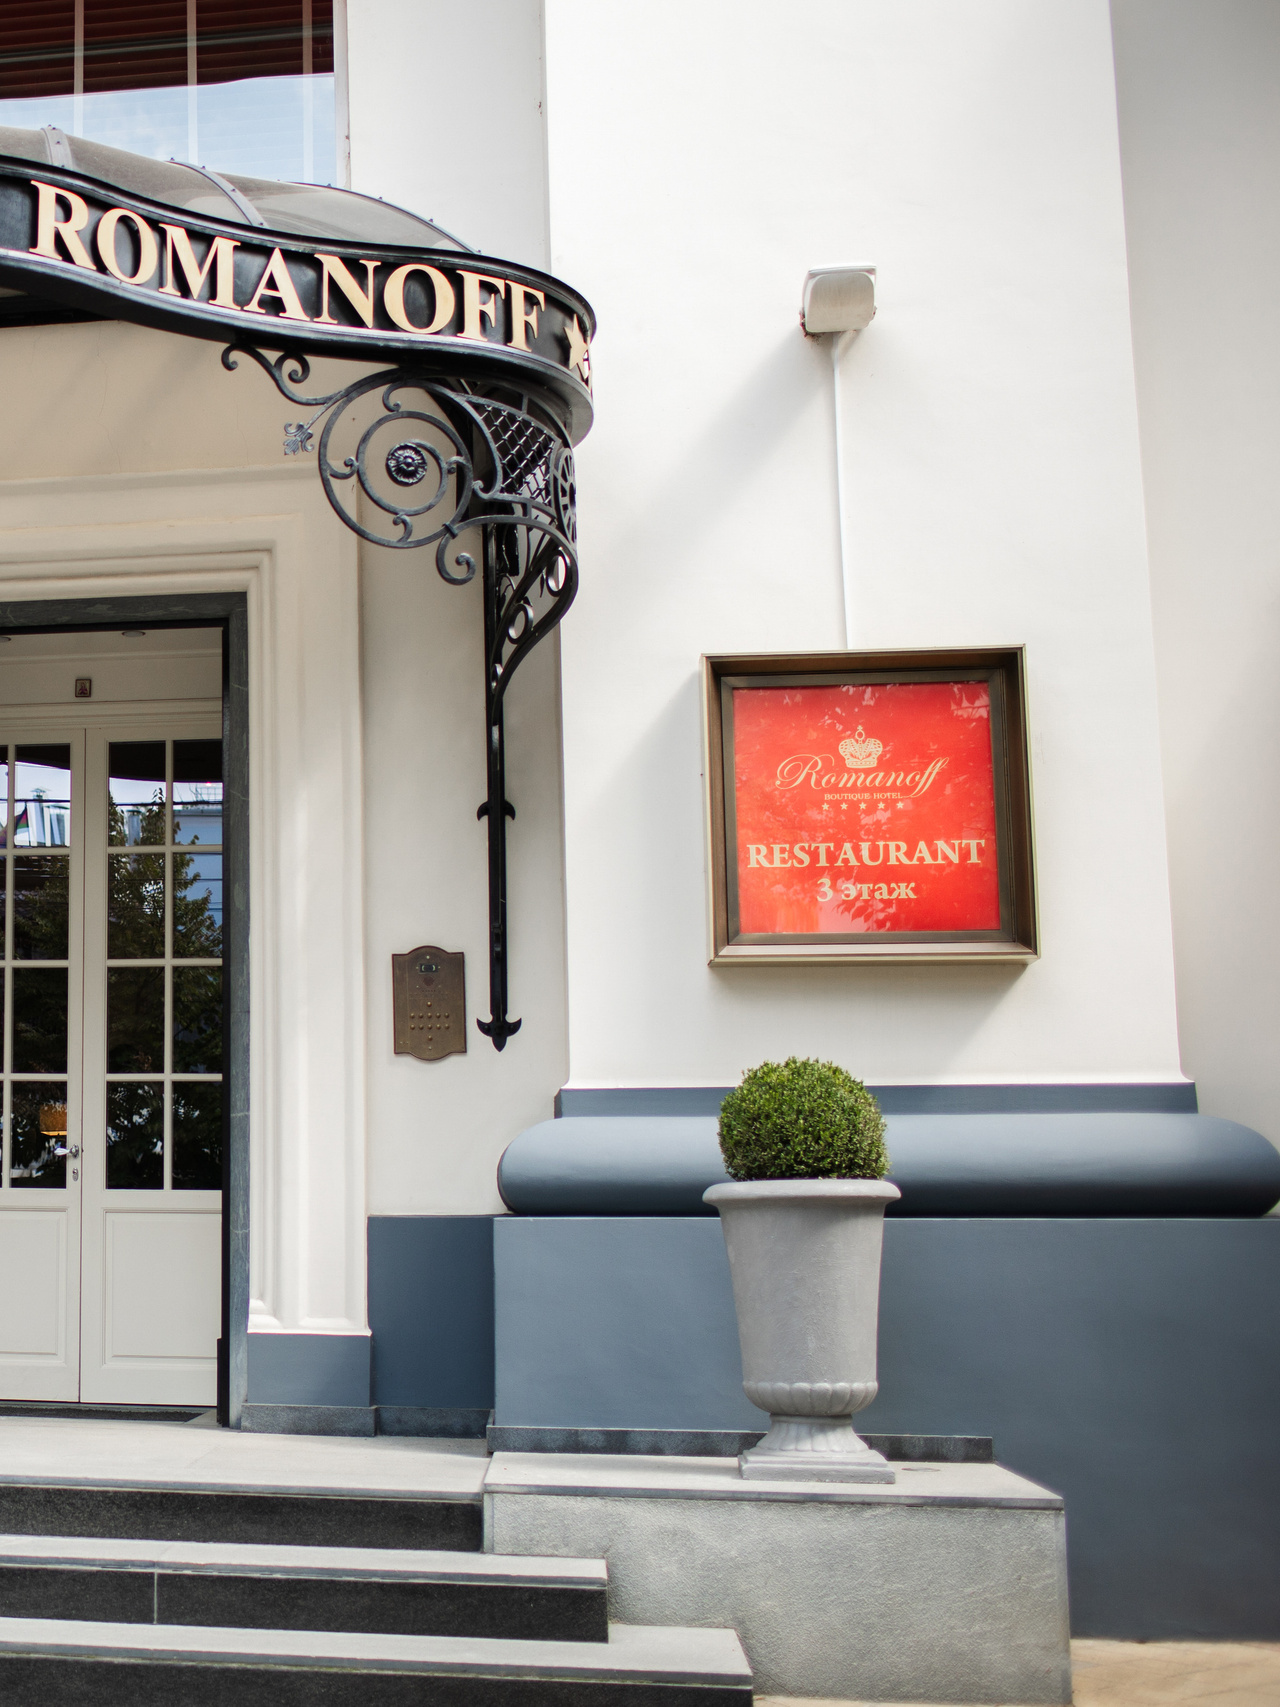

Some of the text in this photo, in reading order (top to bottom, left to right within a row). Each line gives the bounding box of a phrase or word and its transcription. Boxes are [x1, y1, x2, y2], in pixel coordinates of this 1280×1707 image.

[28, 180, 546, 352] ROMANOFF
[775, 754, 949, 798] Romanoff
[873, 792, 903, 800] HOTEL
[747, 839, 986, 868] RESTAURANT
[816, 878, 918, 902] 3 этаж
